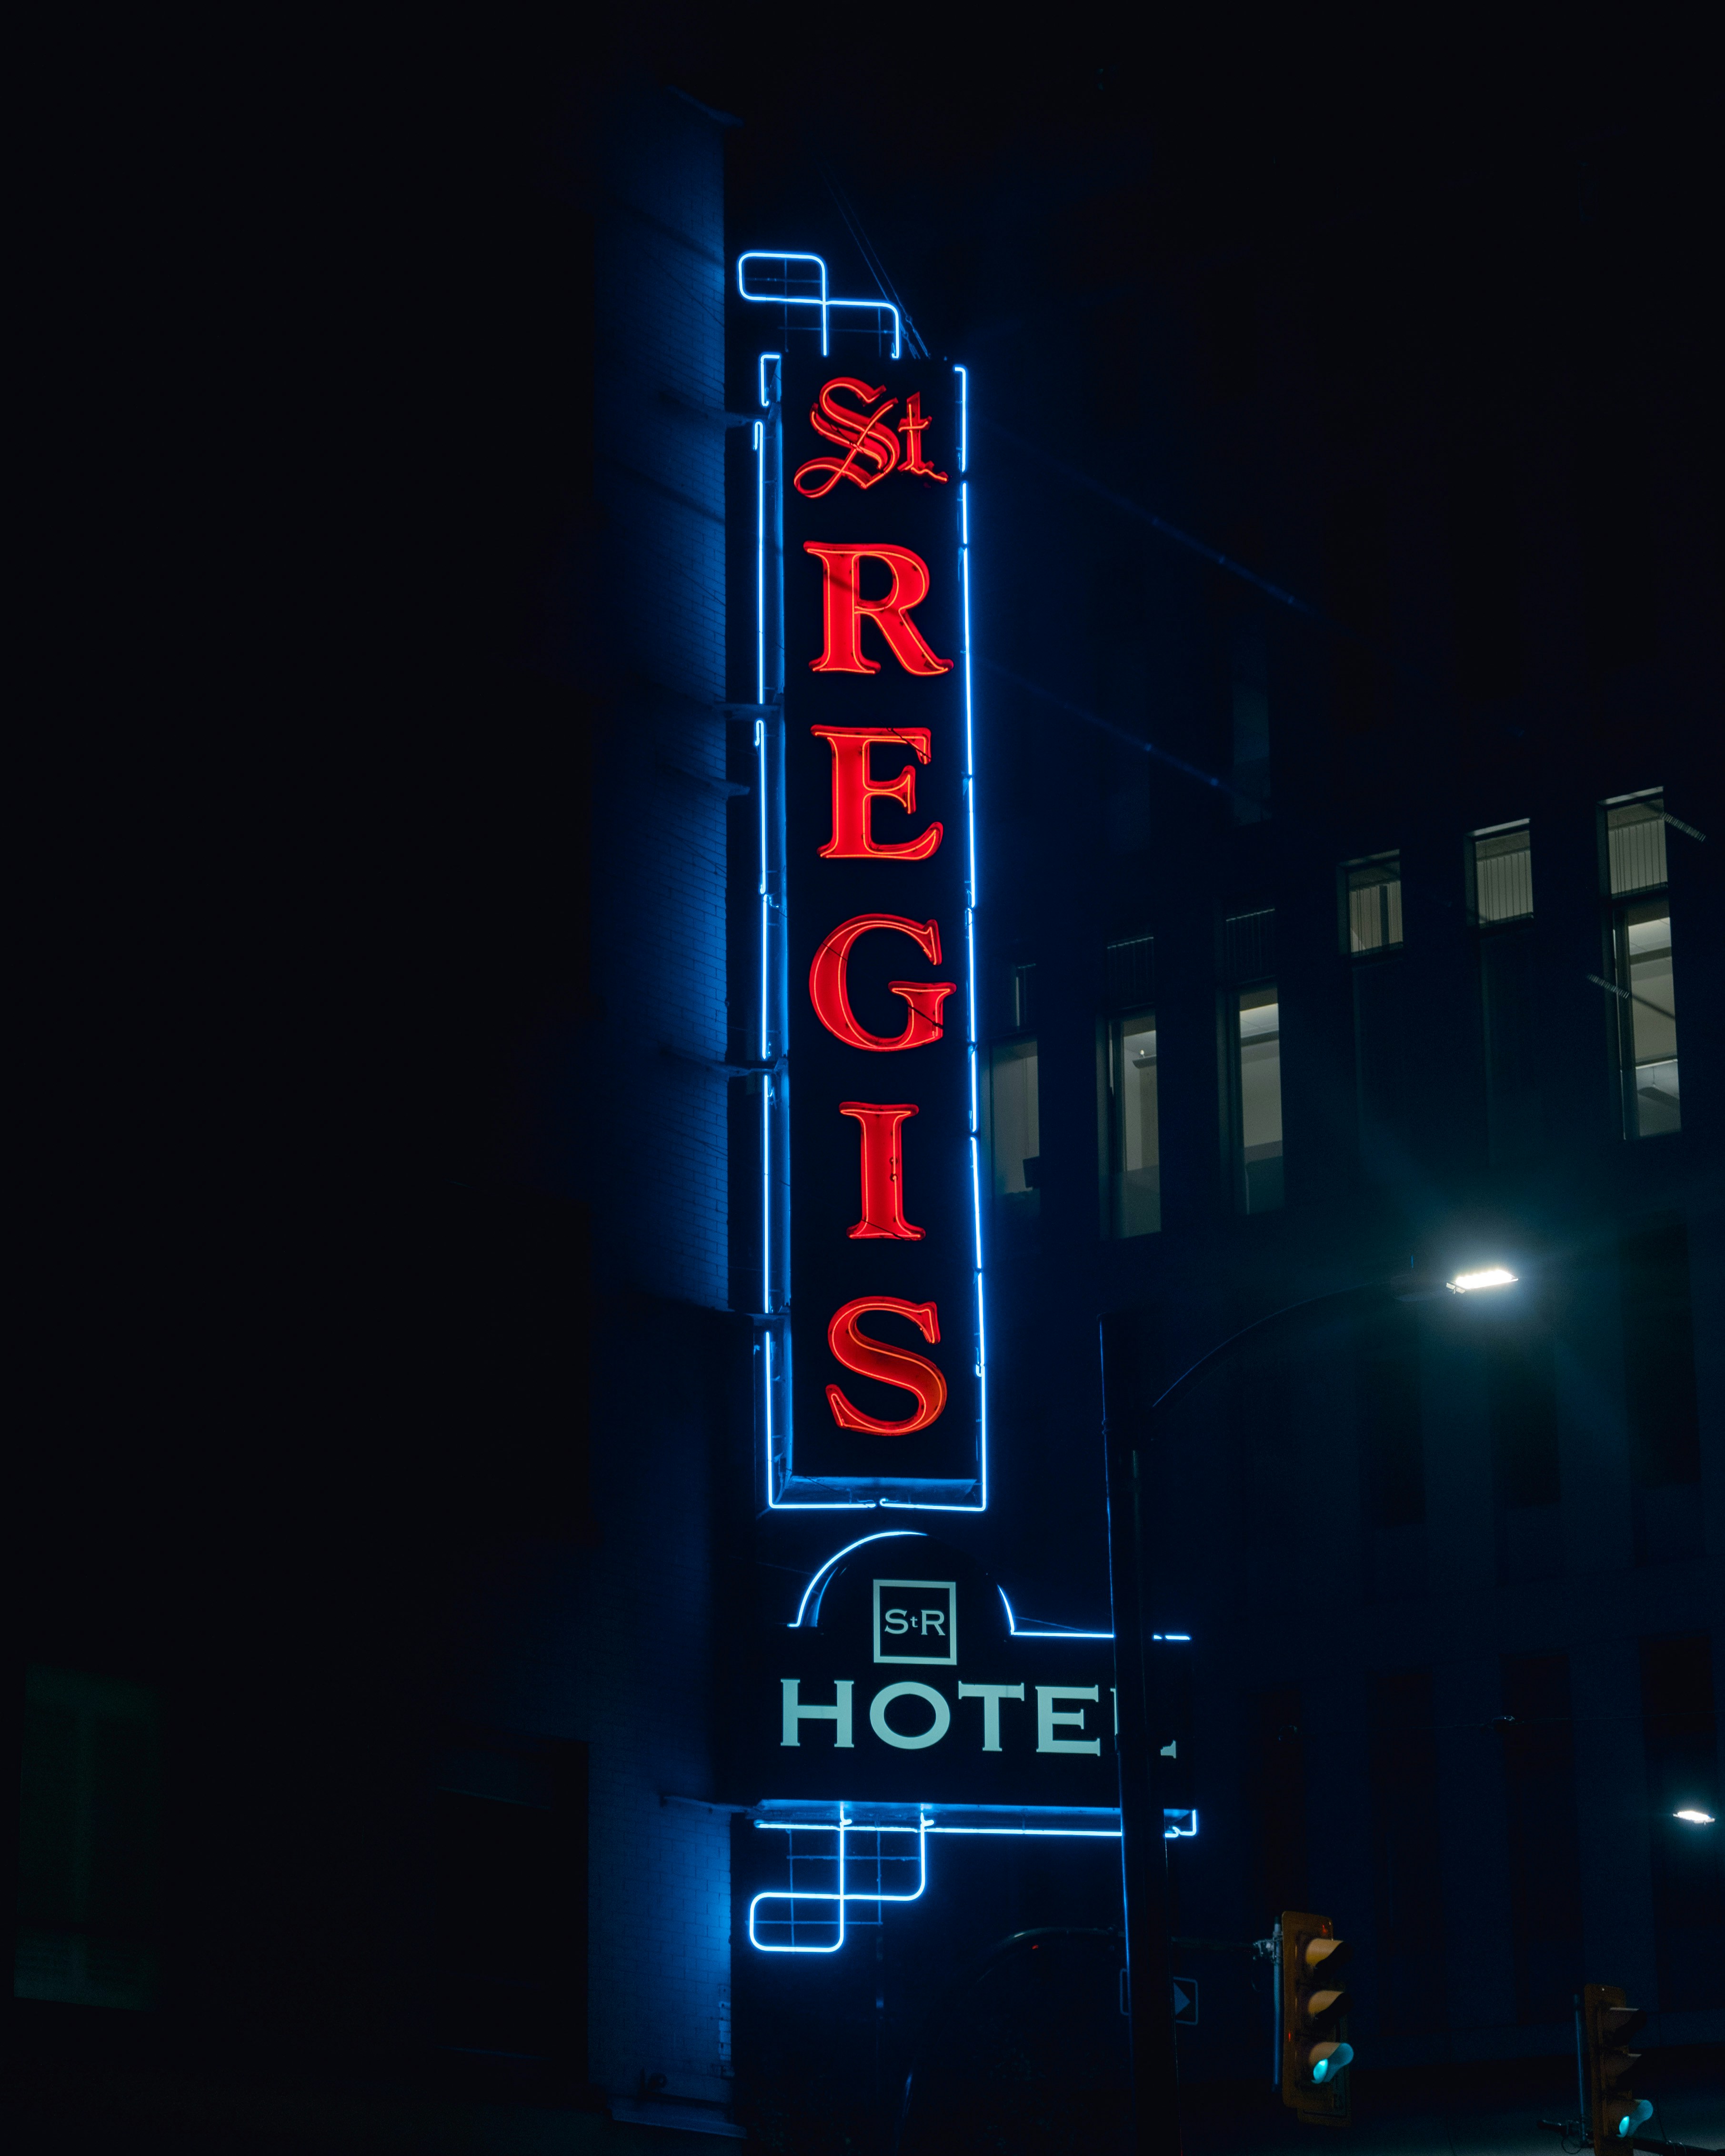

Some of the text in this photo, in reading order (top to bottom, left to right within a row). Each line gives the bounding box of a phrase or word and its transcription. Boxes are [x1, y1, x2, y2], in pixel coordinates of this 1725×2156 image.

[793, 376, 949, 499] St
[802, 540, 957, 1437] REGIS
[884, 1608, 946, 1636] StR
[780, 1678, 1176, 1759] HOTE
